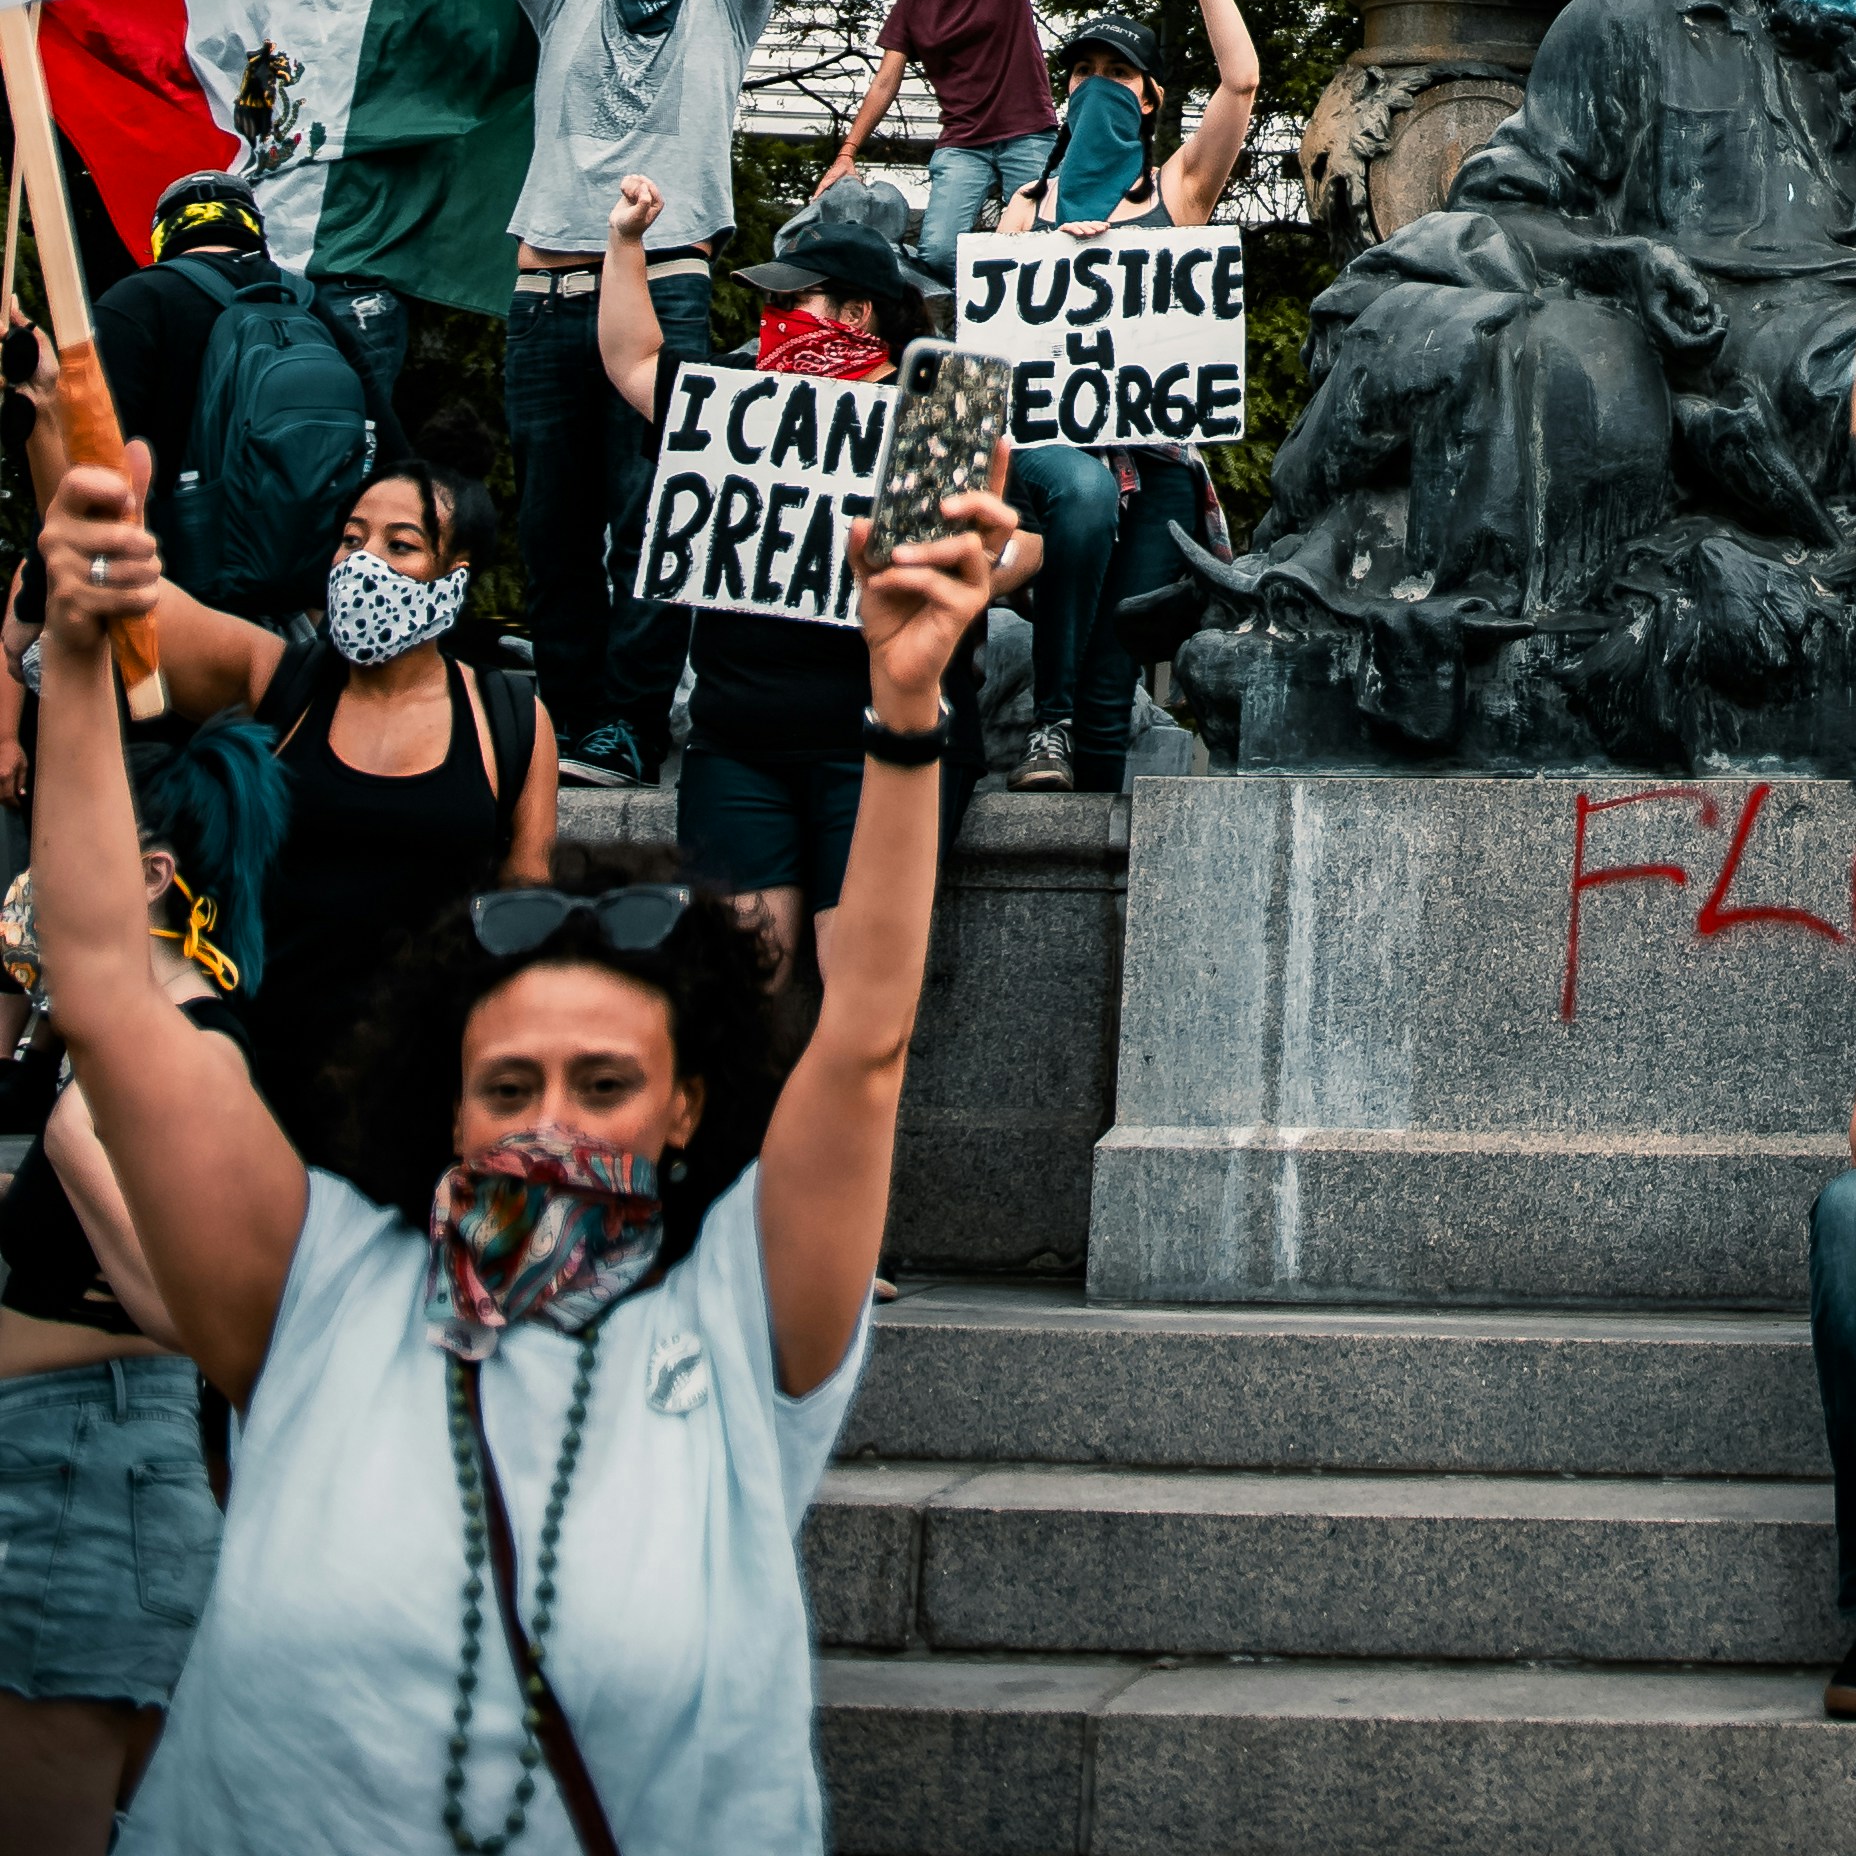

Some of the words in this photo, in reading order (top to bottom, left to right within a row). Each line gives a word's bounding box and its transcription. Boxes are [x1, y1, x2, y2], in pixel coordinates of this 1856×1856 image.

[963, 245, 1242, 327] JUSTICE
[1066, 326, 1115, 371] 4
[667, 374, 717, 453] I
[1003, 358, 1242, 445] EORGE
